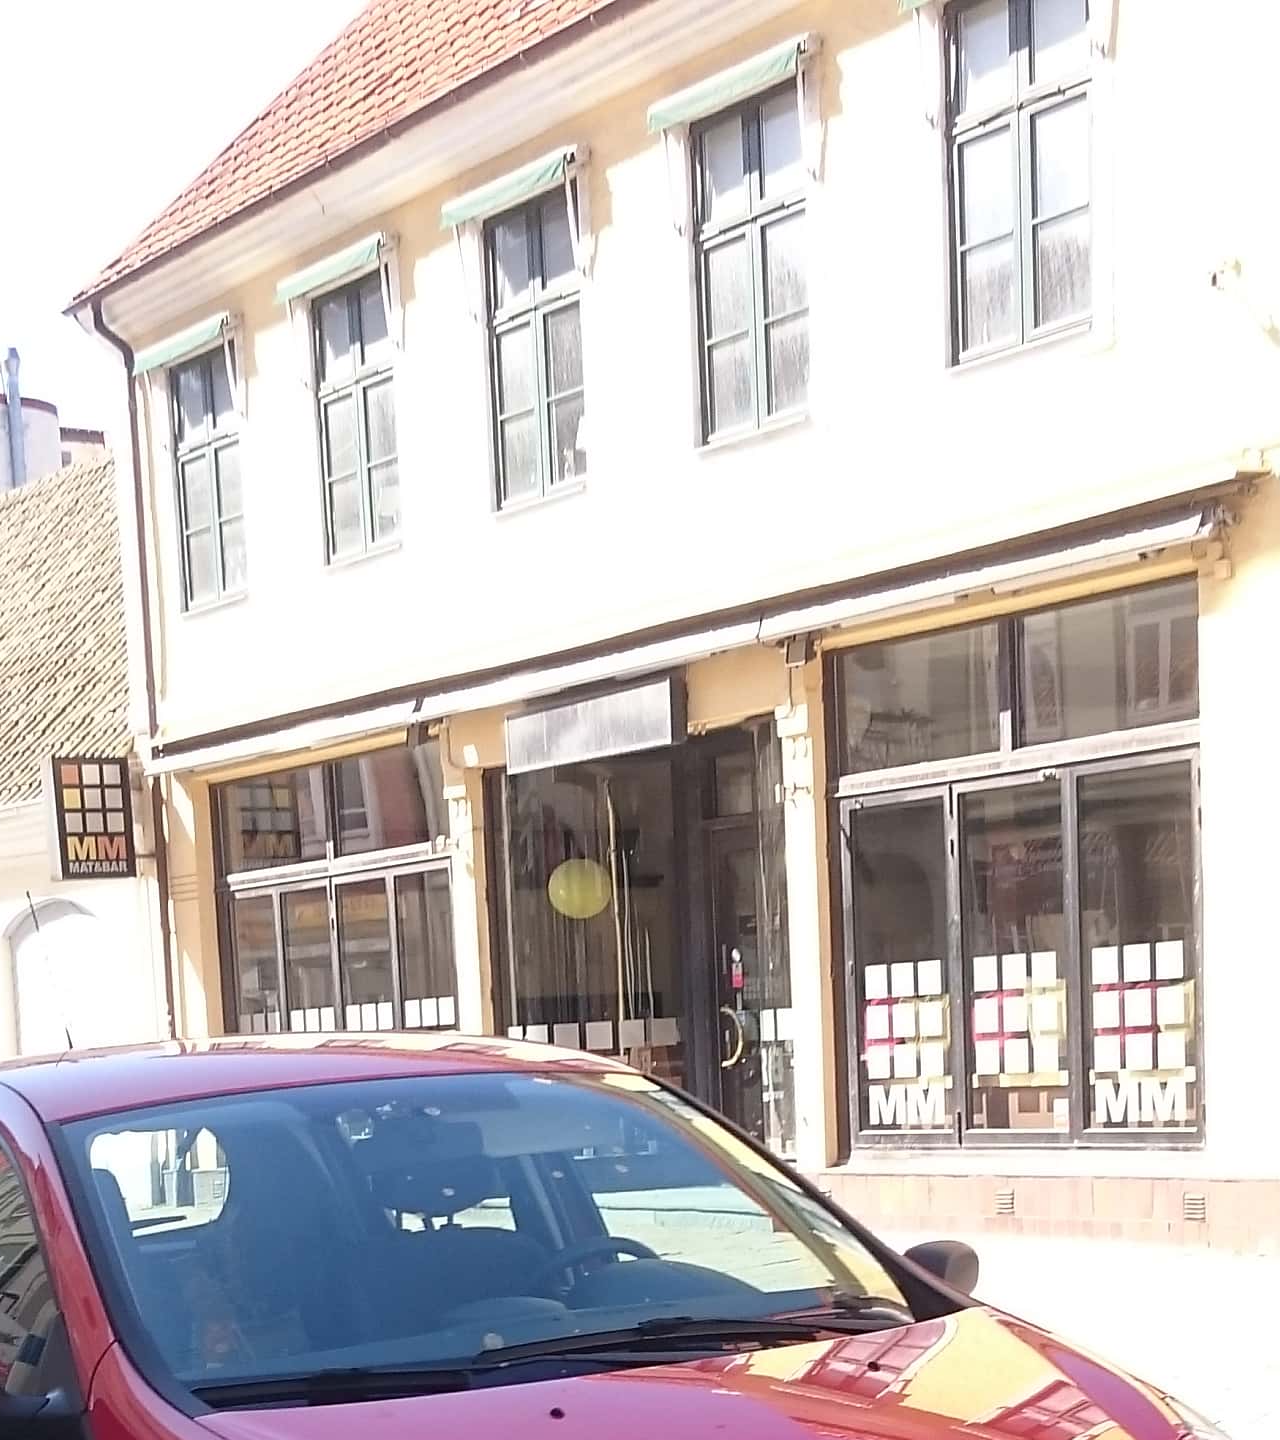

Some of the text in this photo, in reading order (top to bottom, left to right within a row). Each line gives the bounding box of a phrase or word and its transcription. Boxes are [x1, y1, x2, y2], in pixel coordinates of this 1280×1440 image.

[66, 835, 127, 861] MM
[868, 1083, 946, 1126] MM
[1094, 1076, 1188, 1124] MM
